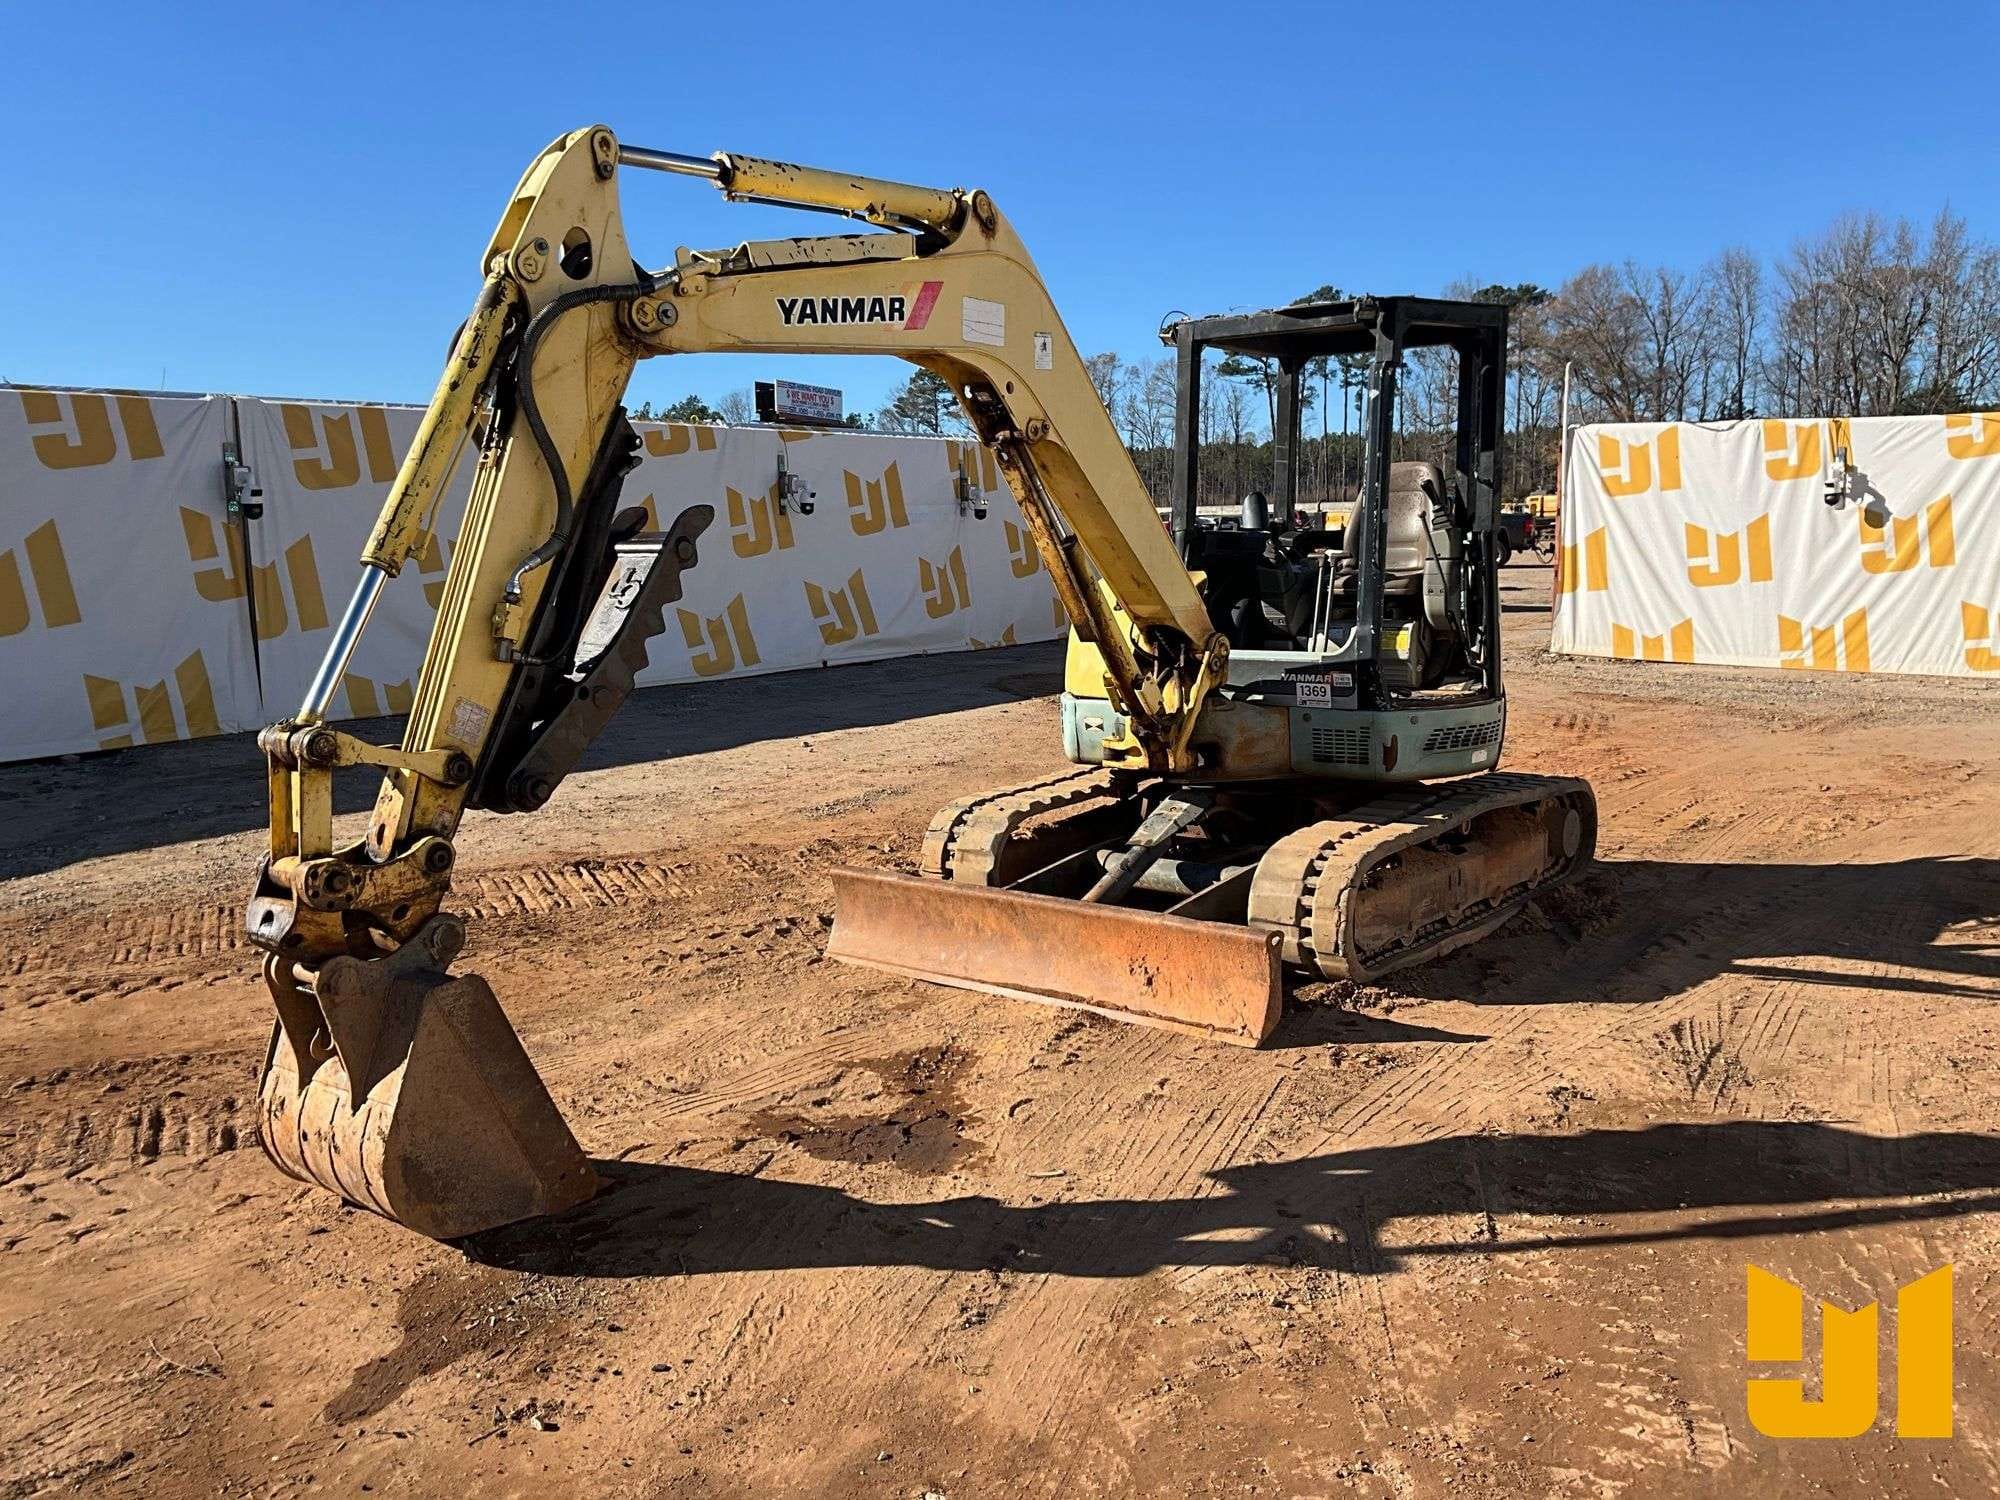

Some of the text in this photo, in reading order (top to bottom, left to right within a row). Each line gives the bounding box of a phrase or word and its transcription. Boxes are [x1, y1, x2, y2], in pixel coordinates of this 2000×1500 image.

[777, 296, 906, 326] YANMAR
[801, 391, 817, 403] WANT
[818, 393, 830, 404] YOU
[1281, 673, 1332, 683] YANMAR
[1299, 685, 1327, 697] 1369
